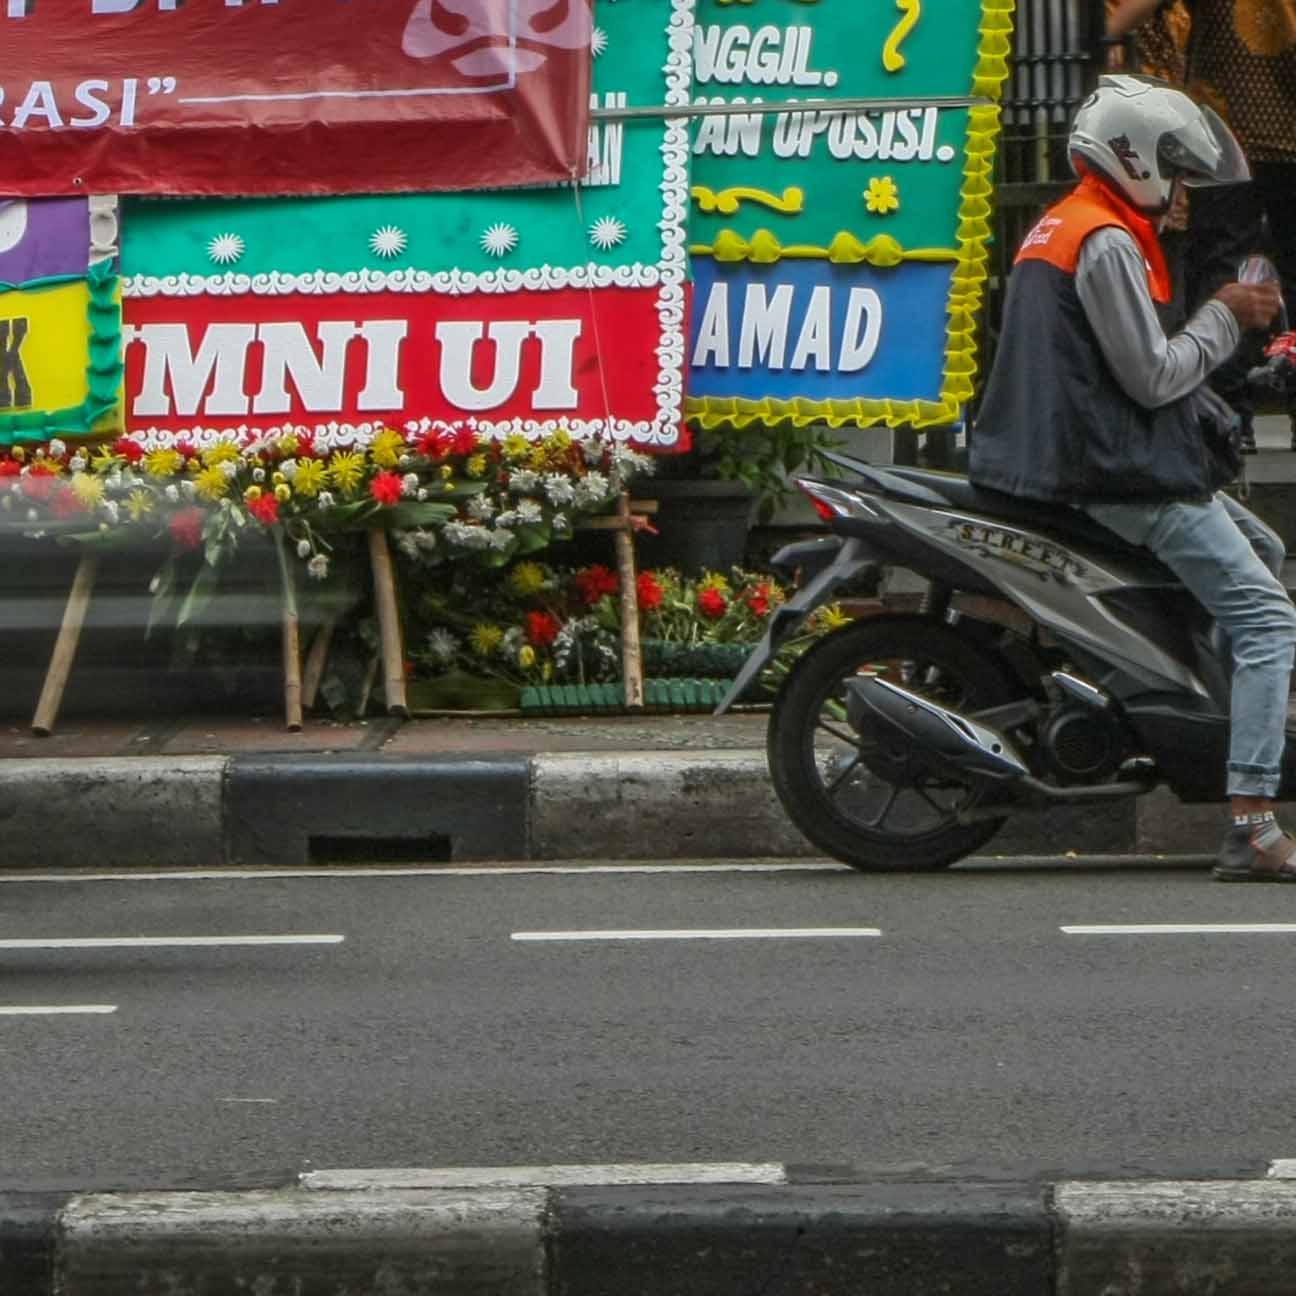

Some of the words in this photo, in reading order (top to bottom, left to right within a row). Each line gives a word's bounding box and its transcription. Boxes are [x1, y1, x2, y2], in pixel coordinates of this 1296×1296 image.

[586, 91, 627, 185] AN
[693, 97, 764, 157] AN
[122, 320, 407, 415] MNI
[436, 319, 581, 410] UI
